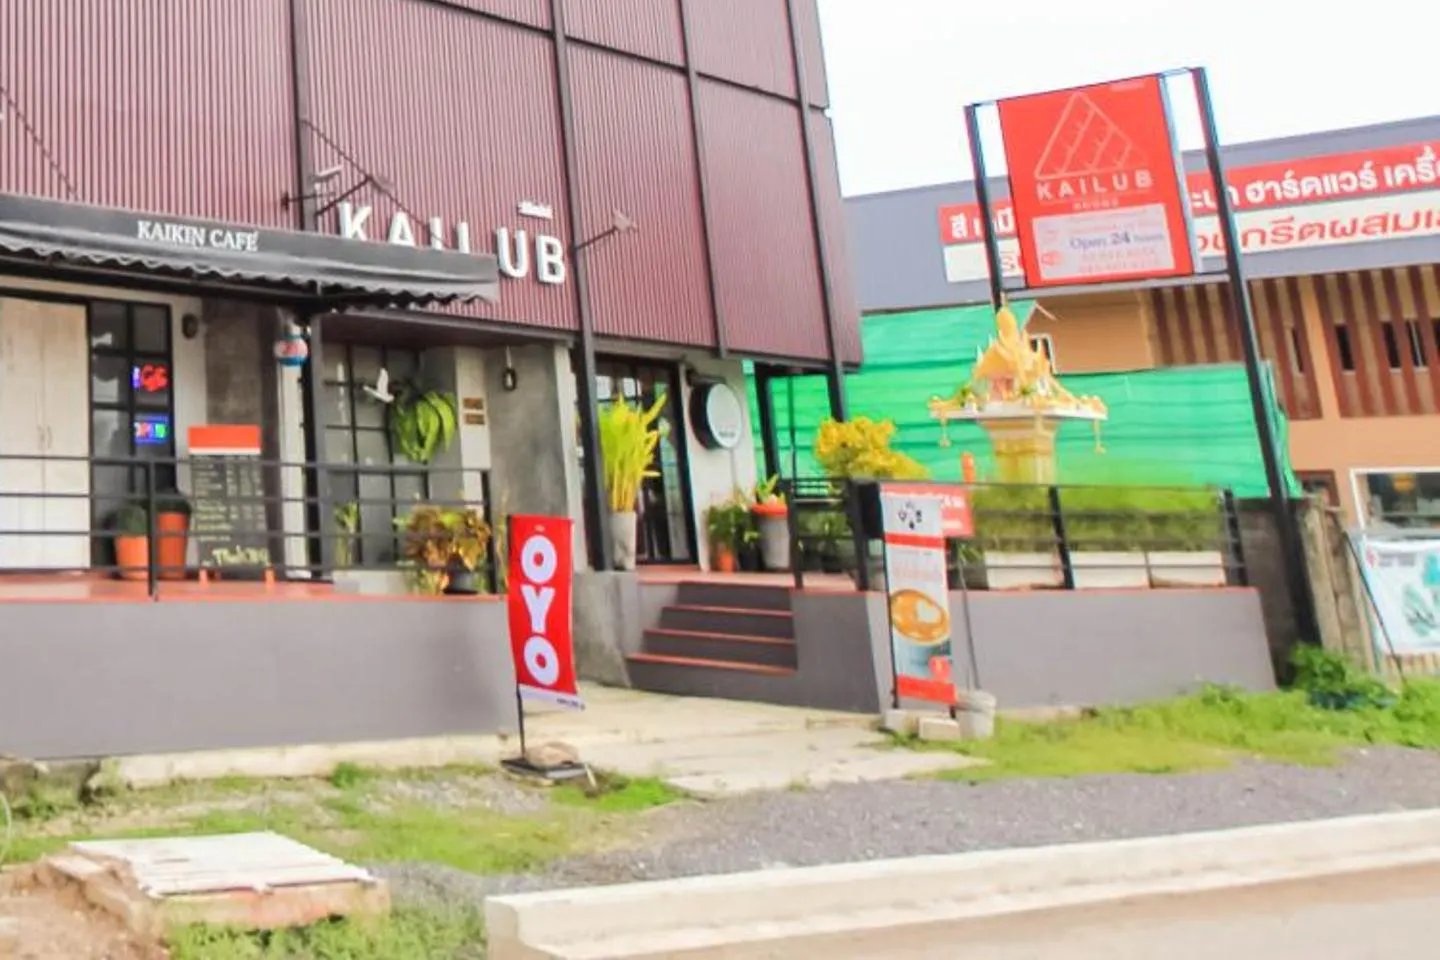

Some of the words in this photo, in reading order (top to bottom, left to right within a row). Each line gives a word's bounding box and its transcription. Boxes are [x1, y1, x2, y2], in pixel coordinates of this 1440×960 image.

[1036, 169, 1153, 201] KAILUB
[1245, 160, 1378, 204] ฮาร์ดแวร์
[137, 220, 206, 248] KAIKIN
[1111, 230, 1131, 246] 24
[521, 534, 560, 686] OYO
